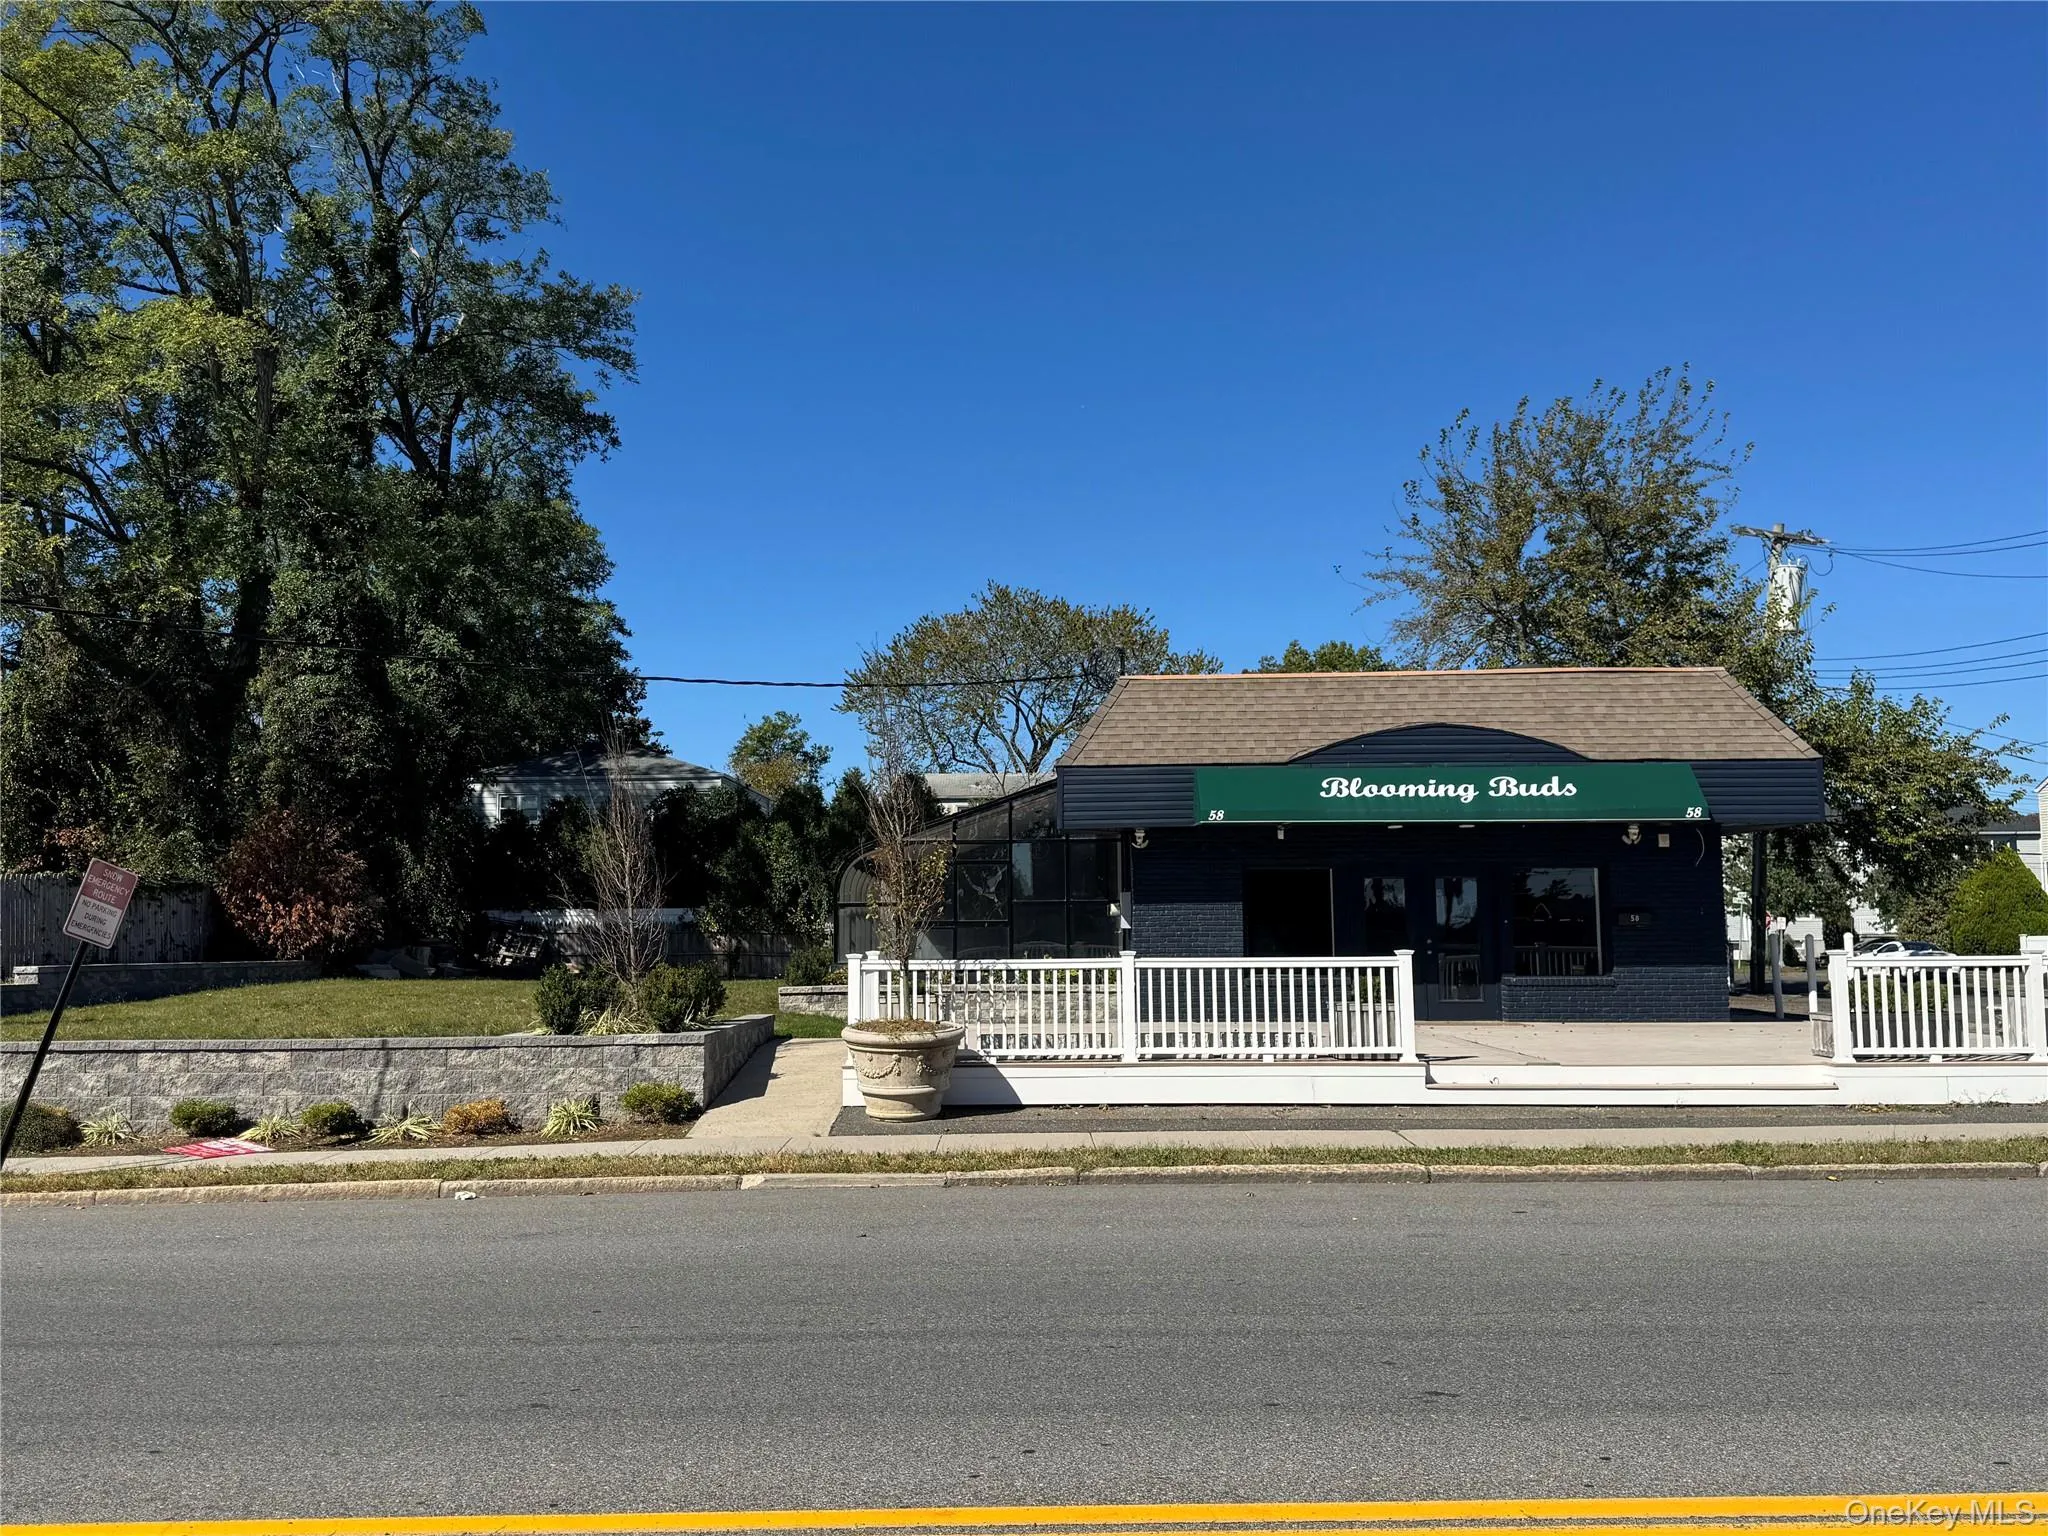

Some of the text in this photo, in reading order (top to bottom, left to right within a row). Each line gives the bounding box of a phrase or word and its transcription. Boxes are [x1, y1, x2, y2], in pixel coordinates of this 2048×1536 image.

[1319, 775, 1577, 803] Blooming Buds
[1208, 810, 1225, 821] 58
[1685, 807, 1703, 818] 58
[103, 869, 122, 883] SNOW
[87, 874, 130, 896] EMERGENCY
[93, 888, 118, 903] ROUTE
[82, 899, 118, 917] NO PARKING
[84, 912, 107, 926] DURING
[71, 919, 112, 939] EMERGENCIES
